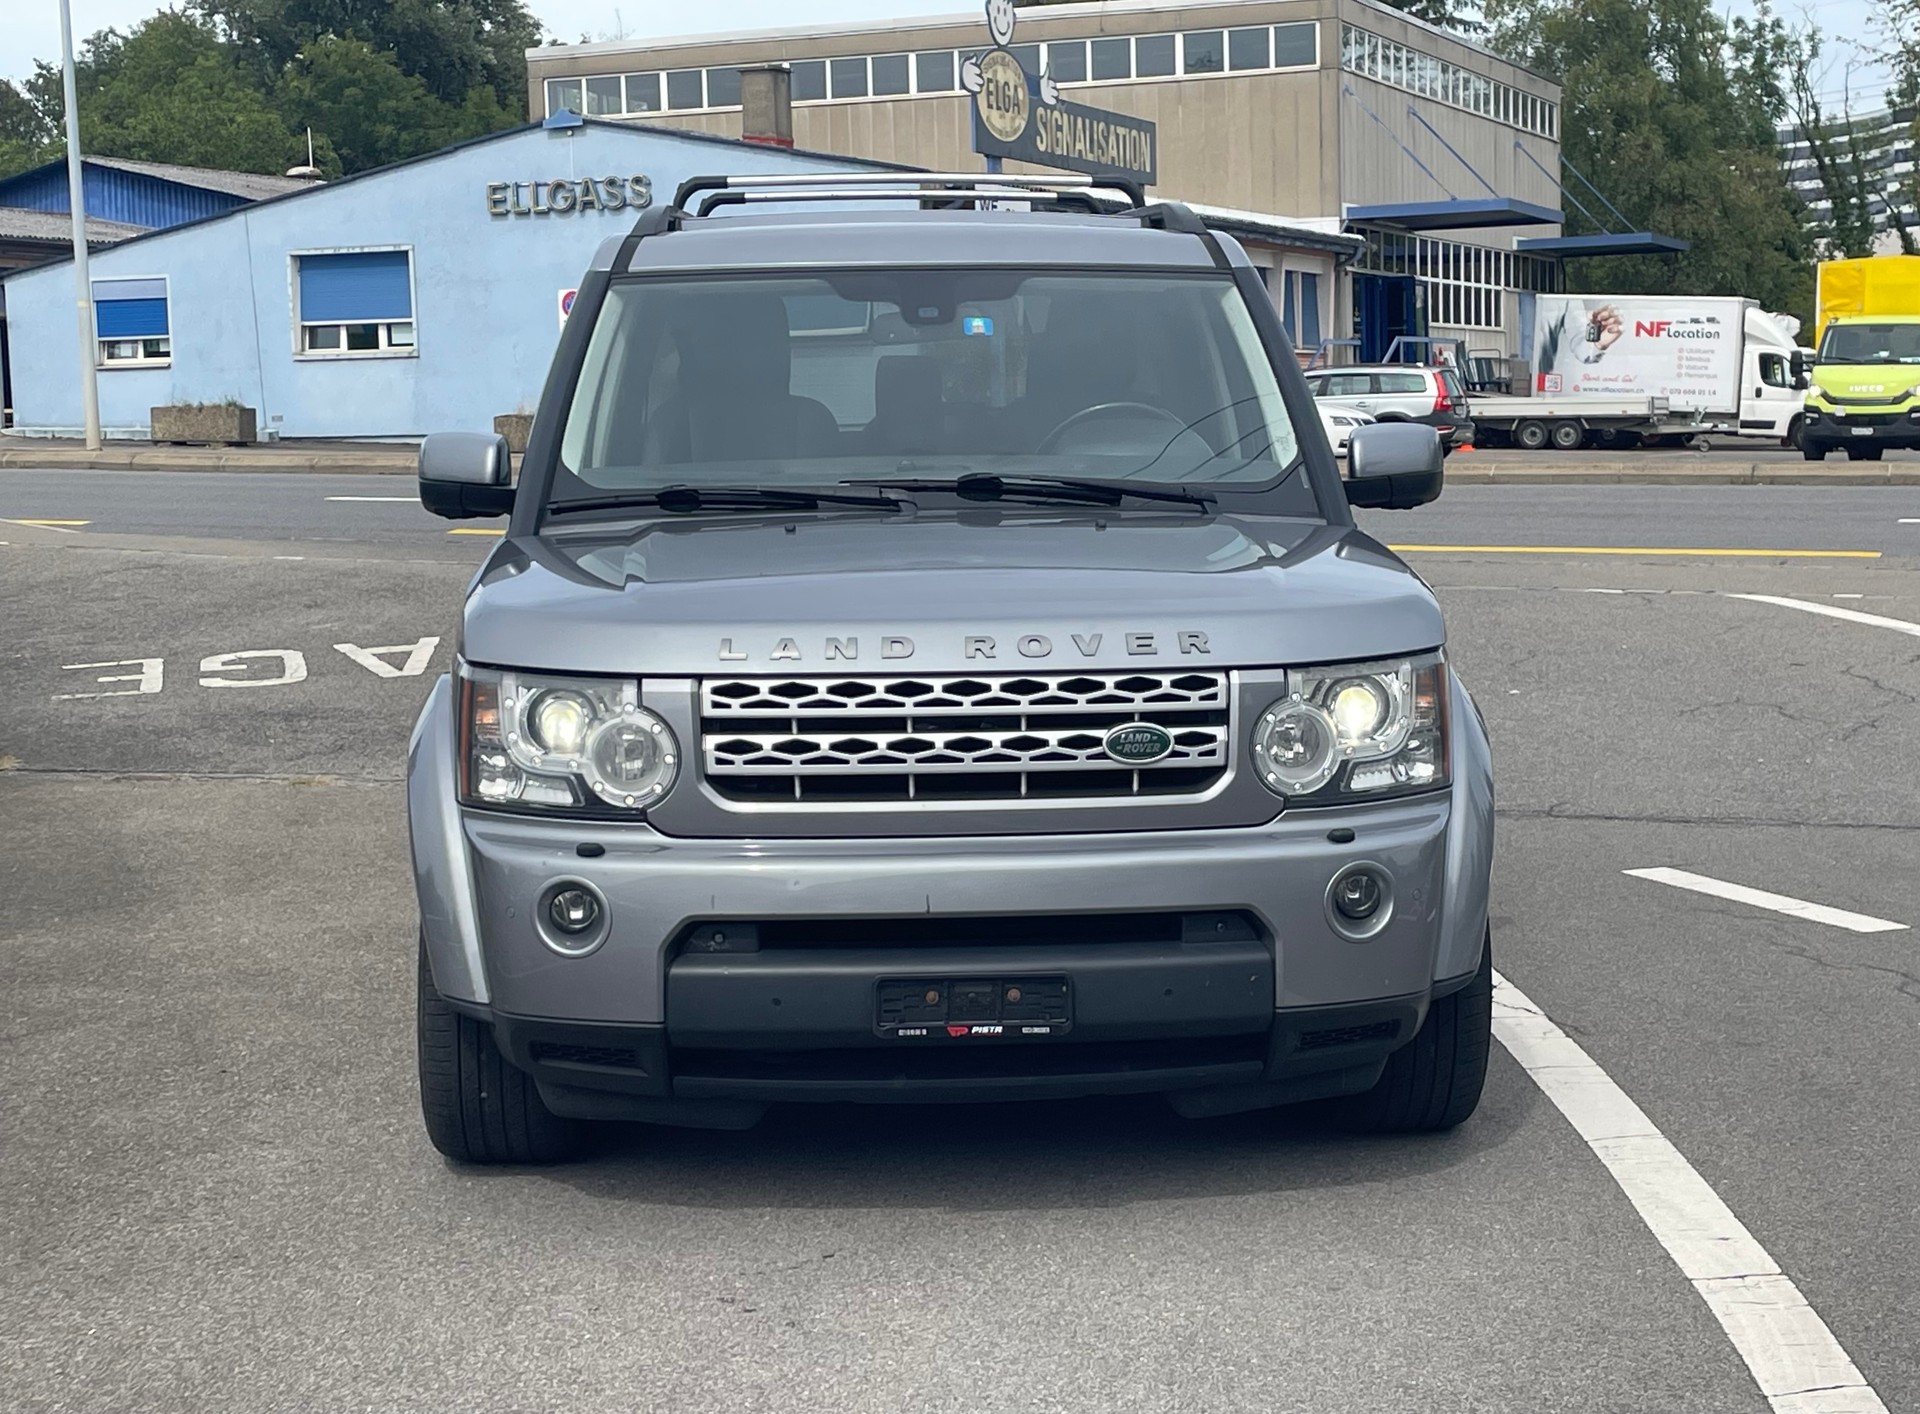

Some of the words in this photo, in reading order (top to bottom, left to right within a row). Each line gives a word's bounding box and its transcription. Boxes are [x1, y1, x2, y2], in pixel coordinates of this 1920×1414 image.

[986, 78, 1020, 114] ELGA
[1036, 106, 1151, 172] SIGNALISATION
[487, 174, 652, 215] ELLGASS
[1635, 320, 1672, 337] NF
[1667, 327, 1720, 339] Location
[1849, 384, 1884, 393] IVECO
[718, 636, 915, 661] LAND
[964, 630, 1211, 659] ROVER
